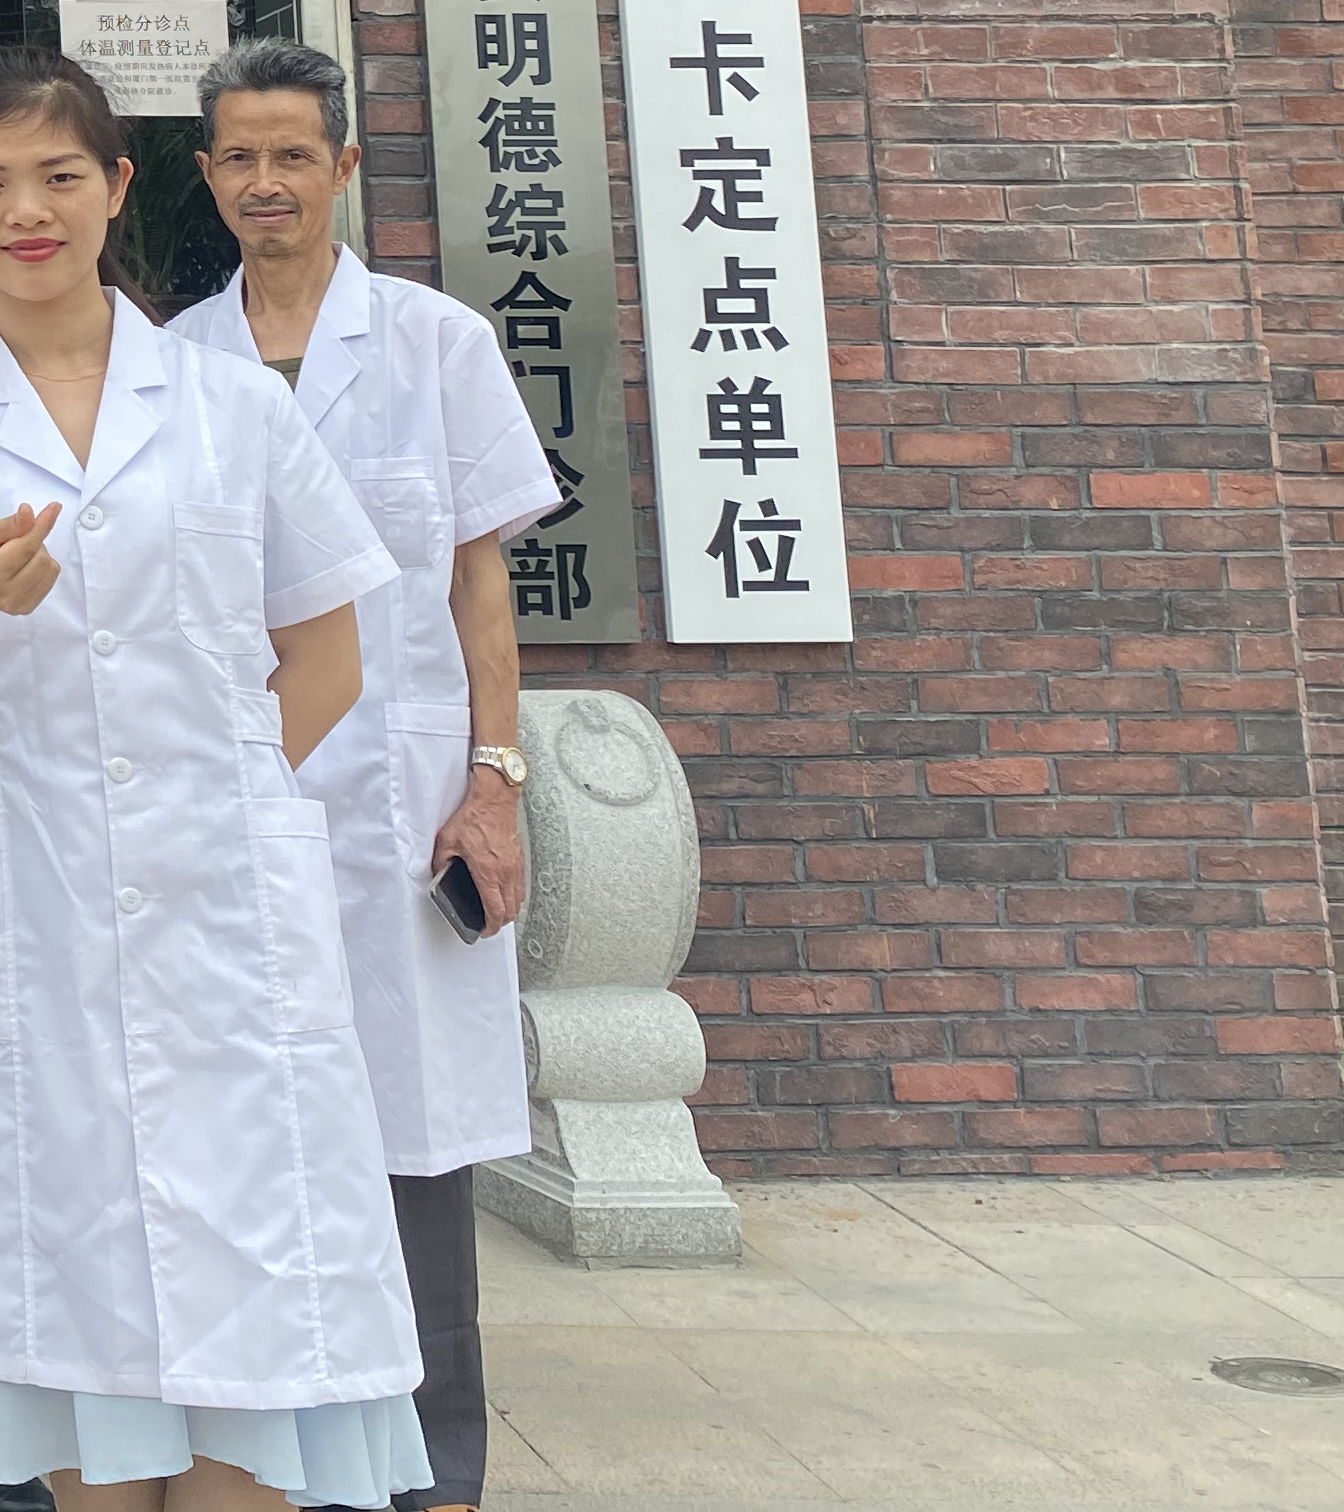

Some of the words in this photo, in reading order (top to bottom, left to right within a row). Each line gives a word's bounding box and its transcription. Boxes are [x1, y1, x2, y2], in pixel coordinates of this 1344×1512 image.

[97, 14, 191, 32] 预检分诊点
[79, 39, 211, 57] 体温测量登记点
